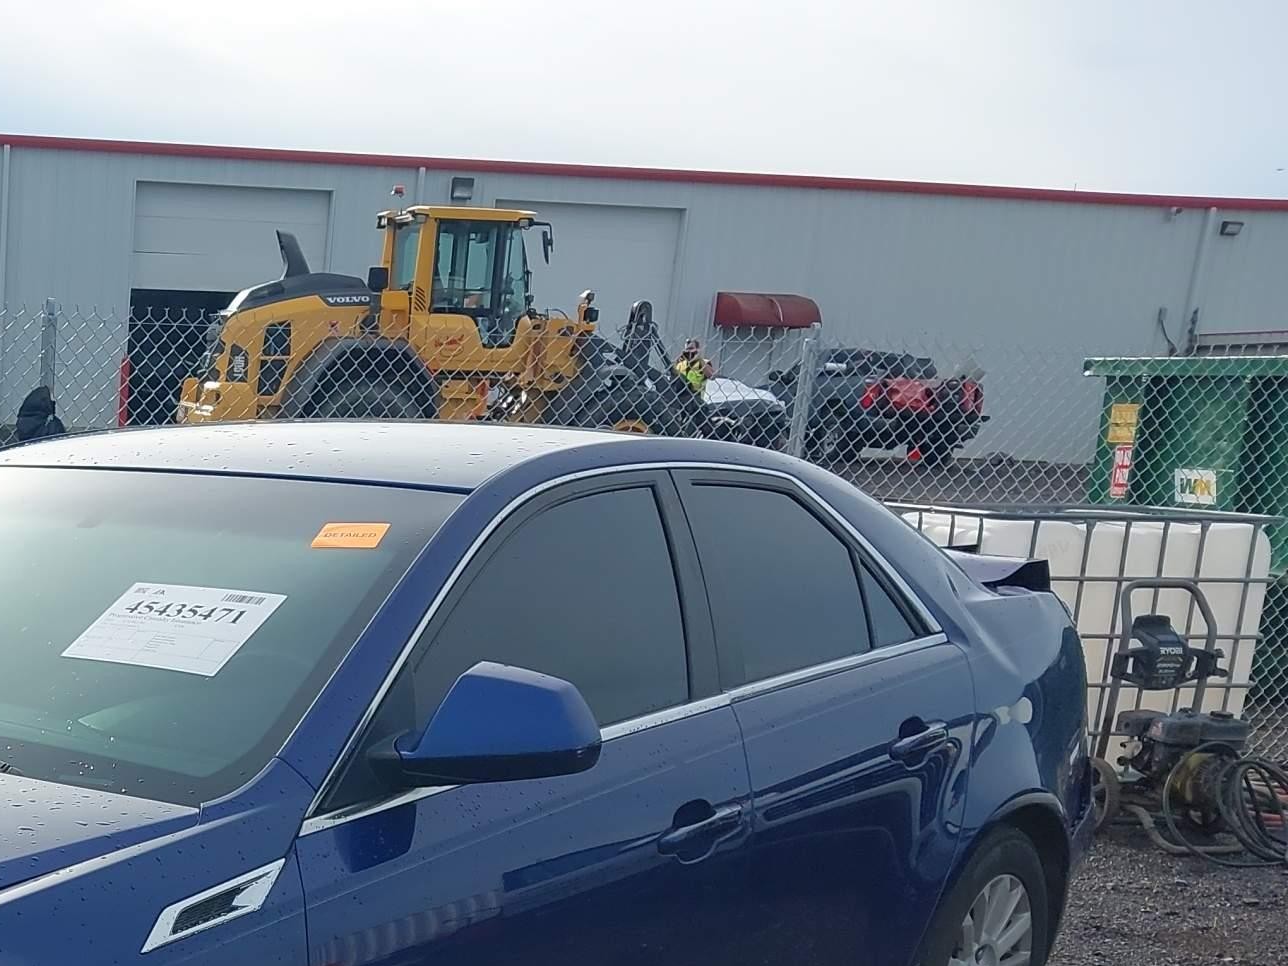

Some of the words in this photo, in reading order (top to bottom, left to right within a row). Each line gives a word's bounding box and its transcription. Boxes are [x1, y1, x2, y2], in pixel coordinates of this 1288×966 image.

[326, 295, 370, 304] VOLVO
[124, 600, 247, 625] 45435471
[1159, 647, 1183, 655] RYOBI
